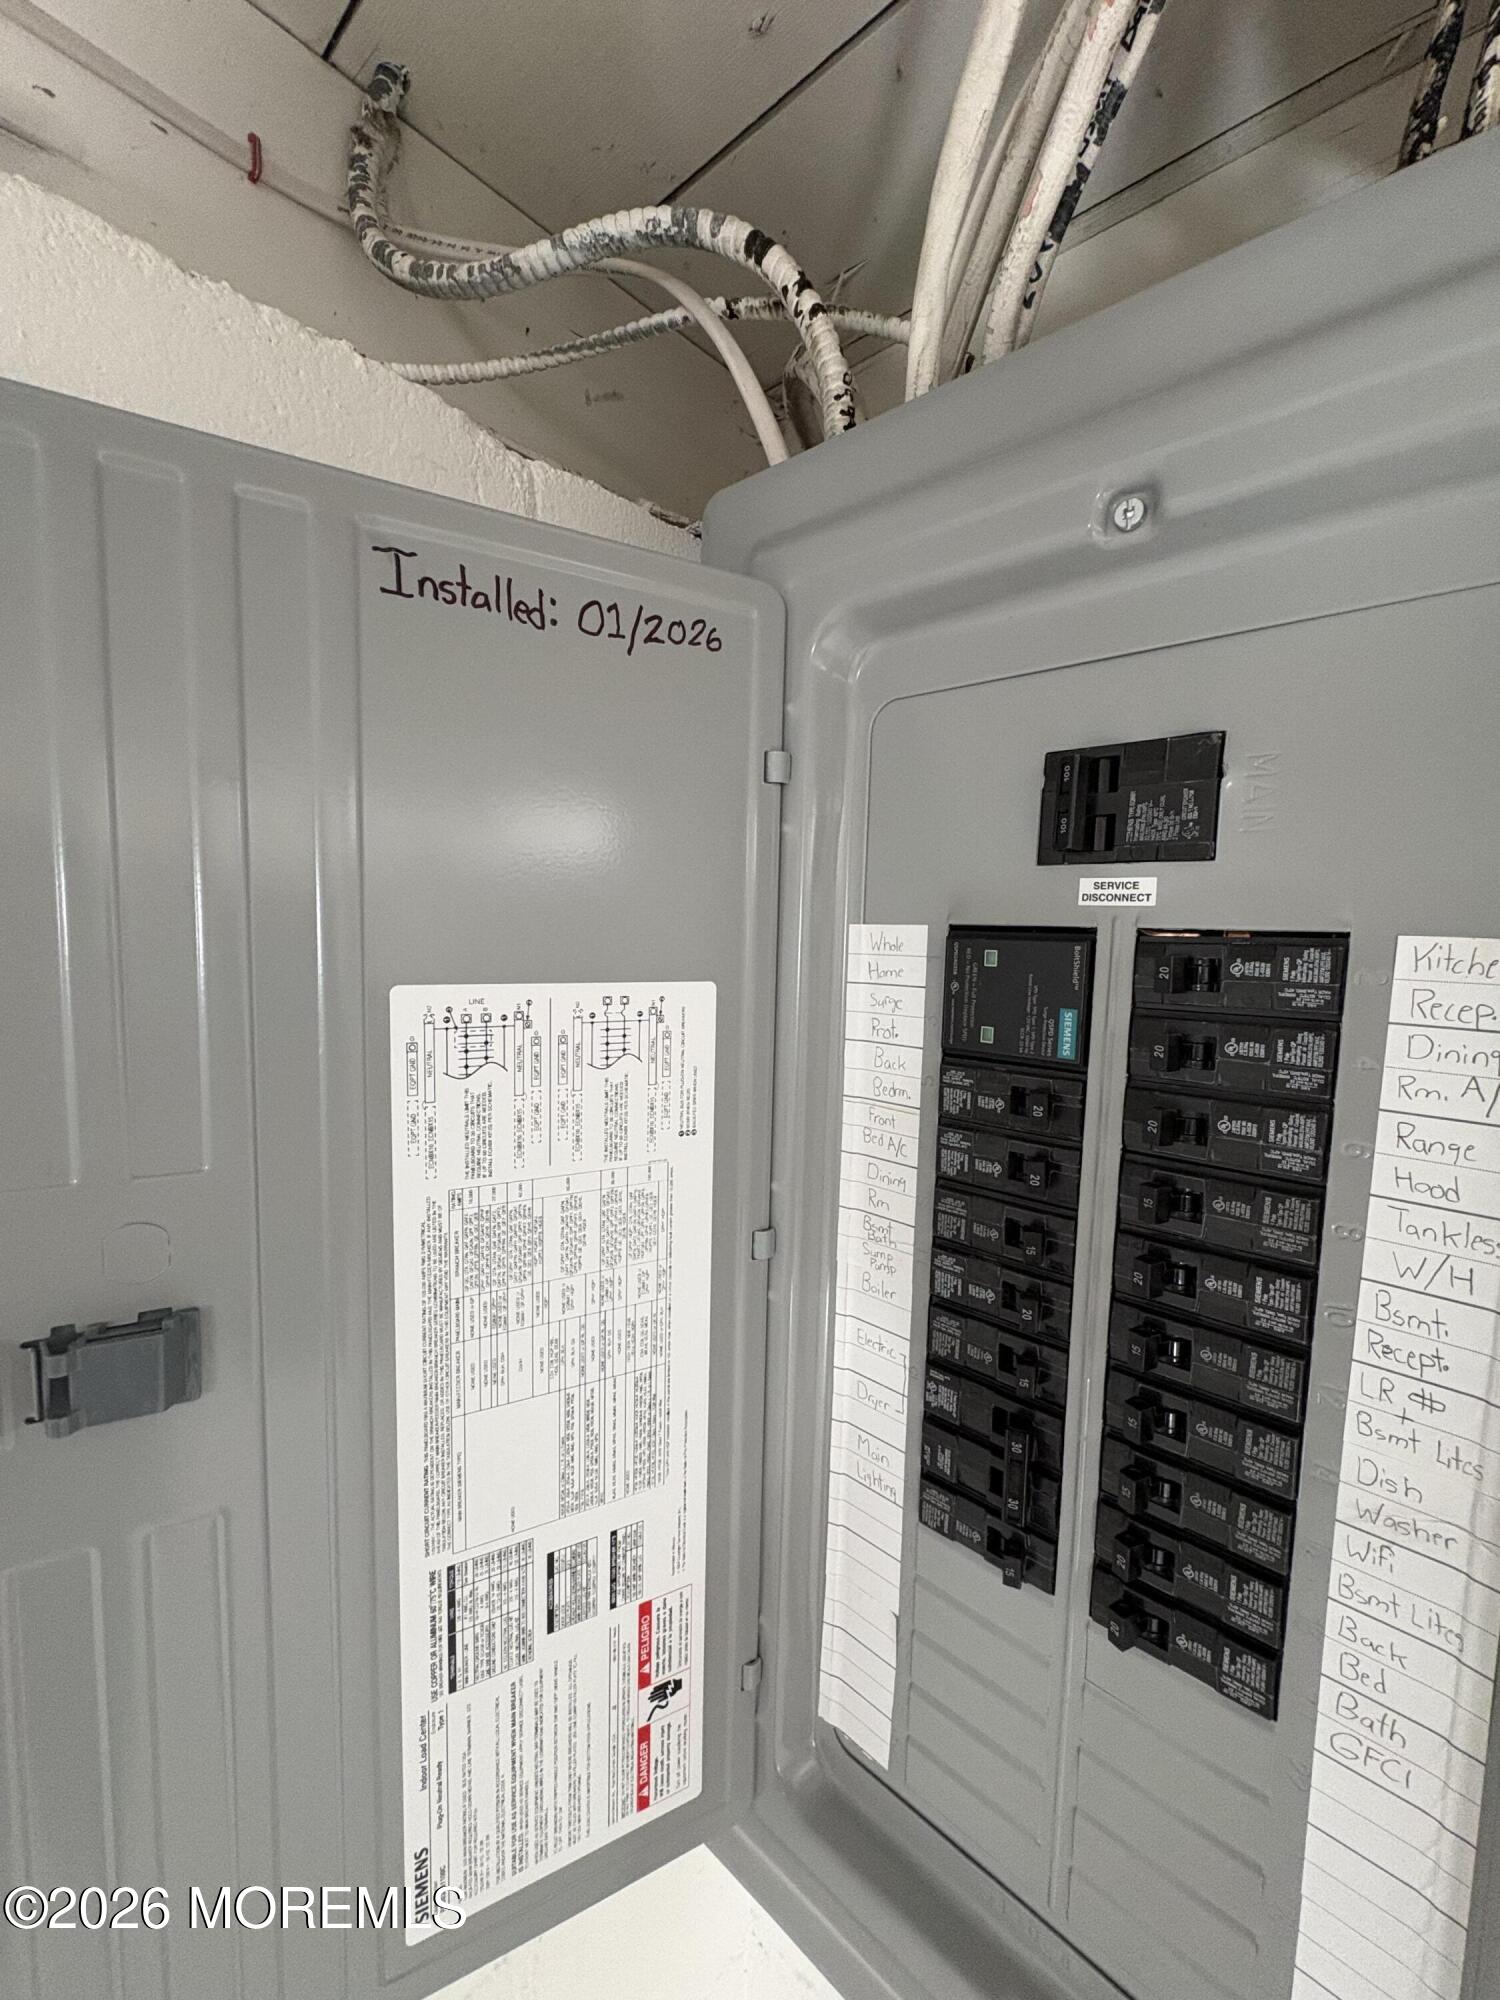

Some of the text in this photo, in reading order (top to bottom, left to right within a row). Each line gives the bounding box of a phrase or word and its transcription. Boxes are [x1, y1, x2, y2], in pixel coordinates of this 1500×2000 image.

[371, 545, 723, 656] Installed: 01/2026
[1063, 765, 1071, 783] 100
[1060, 817, 1068, 834] 100
[1081, 893, 1152, 902] DISCONNECT
[1093, 881, 1140, 890] SERVICE
[870, 931, 904, 953] Whole
[868, 961, 904, 981] Home
[1159, 966, 1170, 980] 20
[870, 993, 903, 1013] Surge
[1411, 988, 1497, 1031] Recep.
[871, 1017, 899, 1040] Prot.
[1062, 1011, 1073, 1056] SIEMENS
[874, 1046, 907, 1071] Back
[1154, 1045, 1165, 1059] 20
[409, 1073, 417, 1090] EQPT
[1399, 1075, 1448, 1101] Rm.
[868, 1108, 896, 1129] Front
[1032, 1105, 1044, 1117] 20
[863, 1126, 884, 1147] Bed
[1147, 1120, 1158, 1134] 20
[1396, 1121, 1477, 1165] Range
[867, 1162, 907, 1193] Dining
[1030, 1174, 1040, 1186] 20
[1394, 1166, 1460, 1203] Hood
[868, 1187, 890, 1211] Rm
[1144, 1198, 1154, 1209] 15
[1026, 1246, 1036, 1256] 15
[861, 1271, 897, 1300] Boiler
[1133, 1272, 1144, 1286] 20
[1392, 1250, 1474, 1296] W/H
[1022, 1308, 1032, 1321] 20
[1375, 1289, 1449, 1340] Bsmt.
[857, 1327, 896, 1359] Electric
[1131, 1344, 1141, 1356] 15
[1367, 1327, 1449, 1378] Recept.
[856, 1380, 891, 1411] Dryer
[1019, 1378, 1030, 1388] 15
[1360, 1371, 1395, 1404] LR
[1356, 1410, 1421, 1454] Bsmt
[857, 1434, 890, 1467] Main
[1011, 1441, 1022, 1454] 30
[1357, 1456, 1423, 1504] Dish
[1007, 1498, 1019, 1510] 30
[1356, 1498, 1457, 1550] Washer
[1338, 1572, 1400, 1619] Bsmt
[429, 1615, 437, 1648] ALUMINUM
[641, 1615, 650, 1661] PELIGRO
[1338, 1615, 1408, 1670] Back
[430, 1650, 437, 1660] OR
[430, 1662, 438, 1688] COPPER
[1339, 1651, 1387, 1694] Bed
[430, 1689, 438, 1703] USE
[437, 1715, 446, 1730] Type
[1336, 1691, 1406, 1749] Bath
[419, 1714, 428, 1791] Indoor Load Center
[640, 1741, 649, 1784] DANGER
[413, 1847, 430, 1924] SIEMENS
